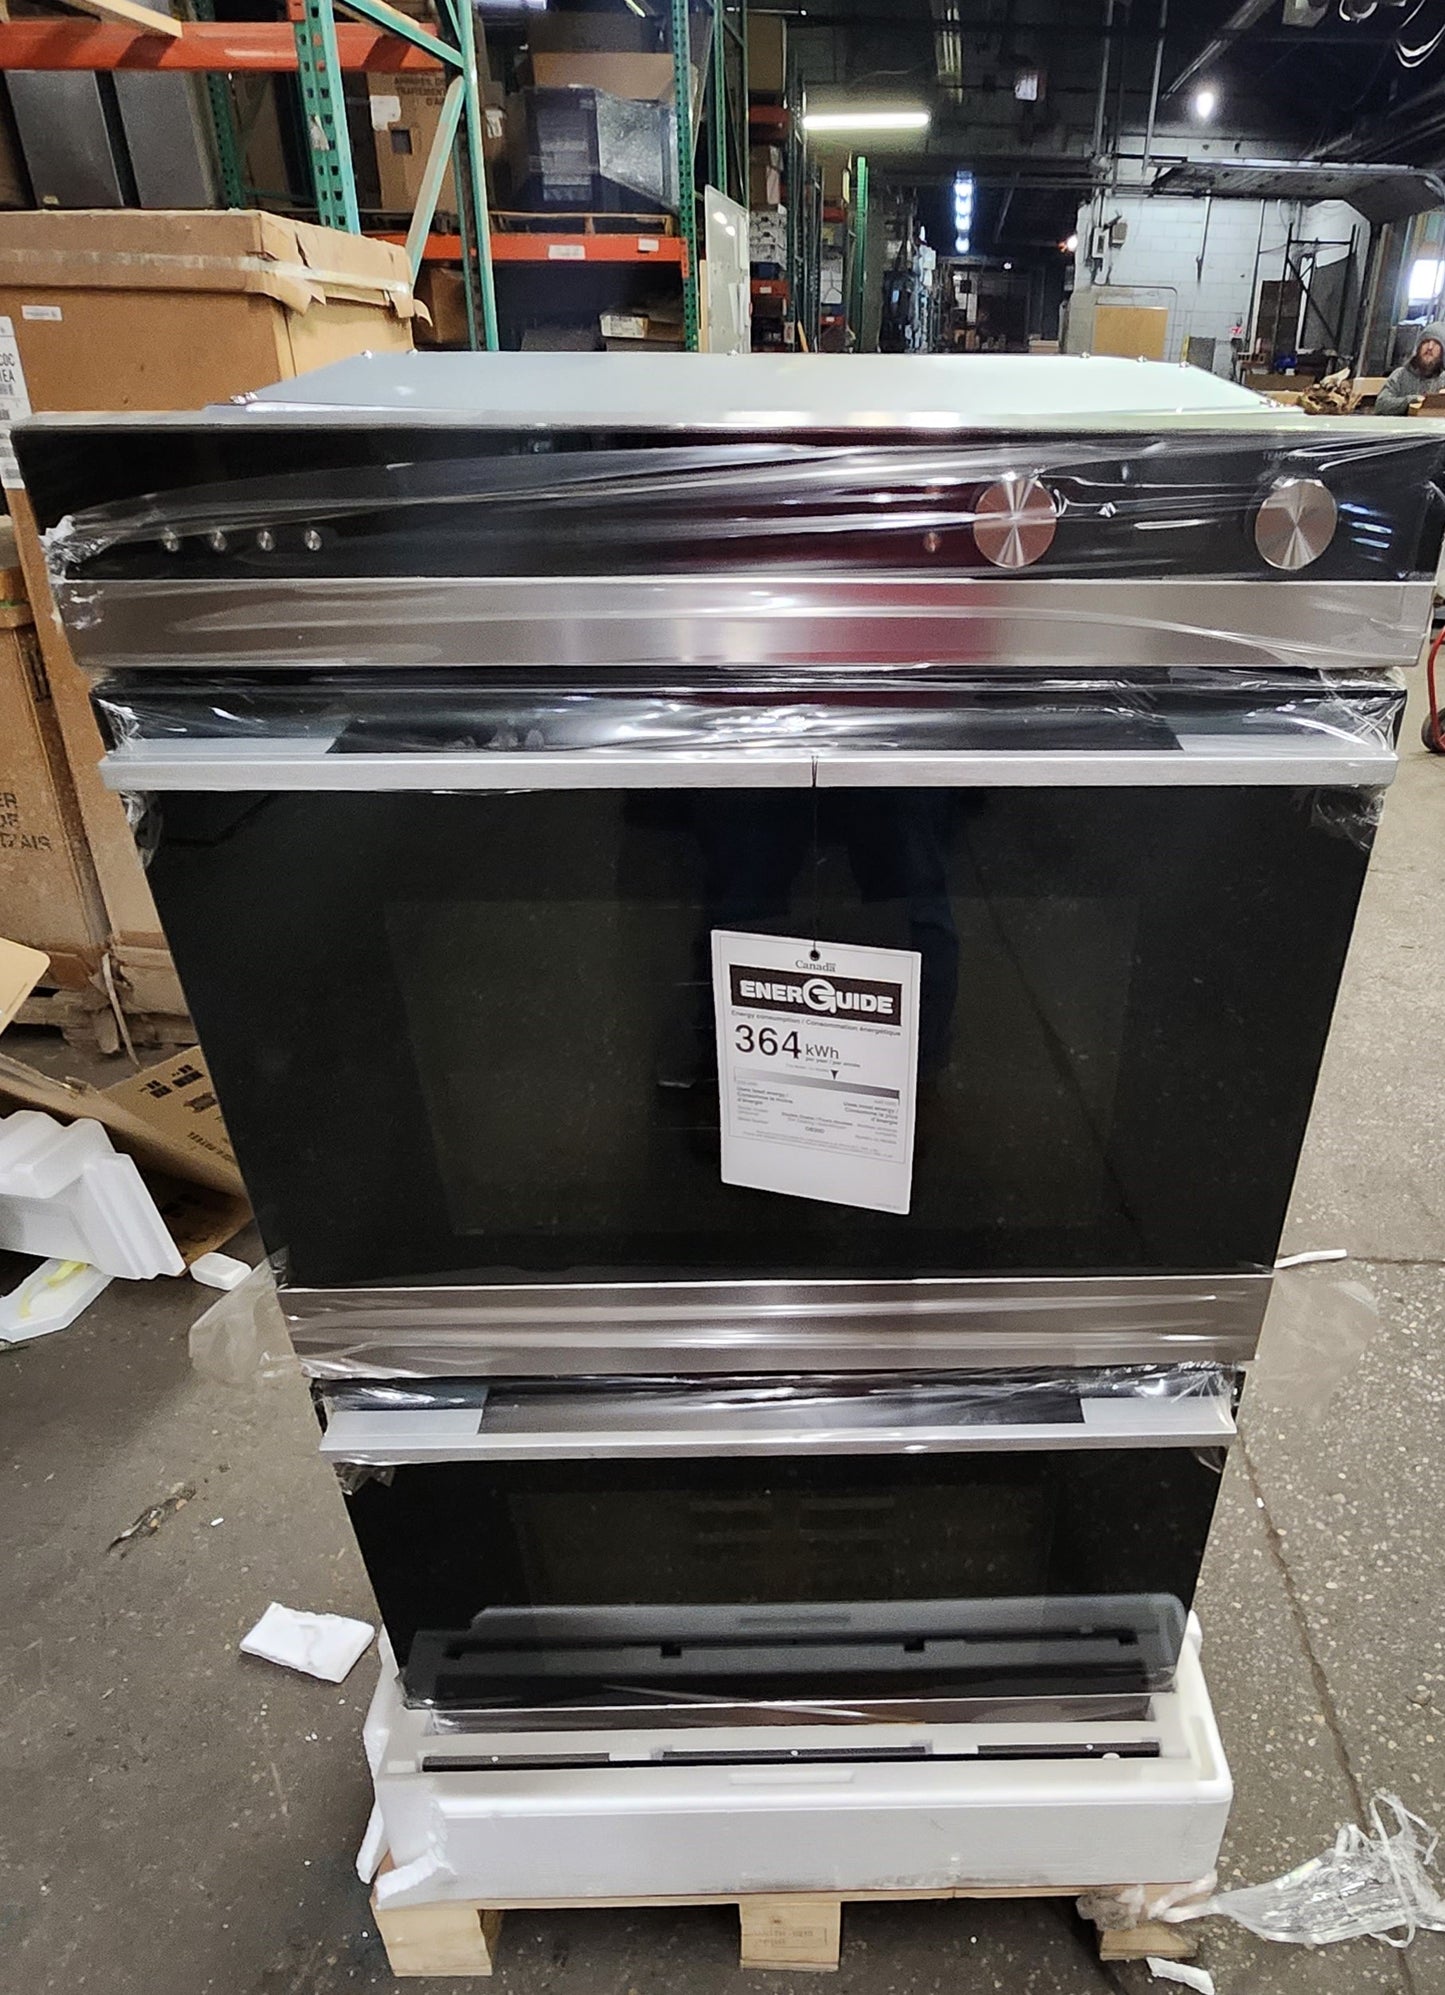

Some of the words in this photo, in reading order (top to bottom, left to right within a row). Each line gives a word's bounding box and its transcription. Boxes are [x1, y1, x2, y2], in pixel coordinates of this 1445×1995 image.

[795, 960, 836, 972] Canada
[739, 978, 894, 1014] ENERGUIDE
[731, 1010, 755, 1019] Energy
[756, 1013, 801, 1024] consumption
[806, 1019, 858, 1032] Consommation
[735, 1024, 802, 1059] 364
[805, 1043, 840, 1059] kWh
